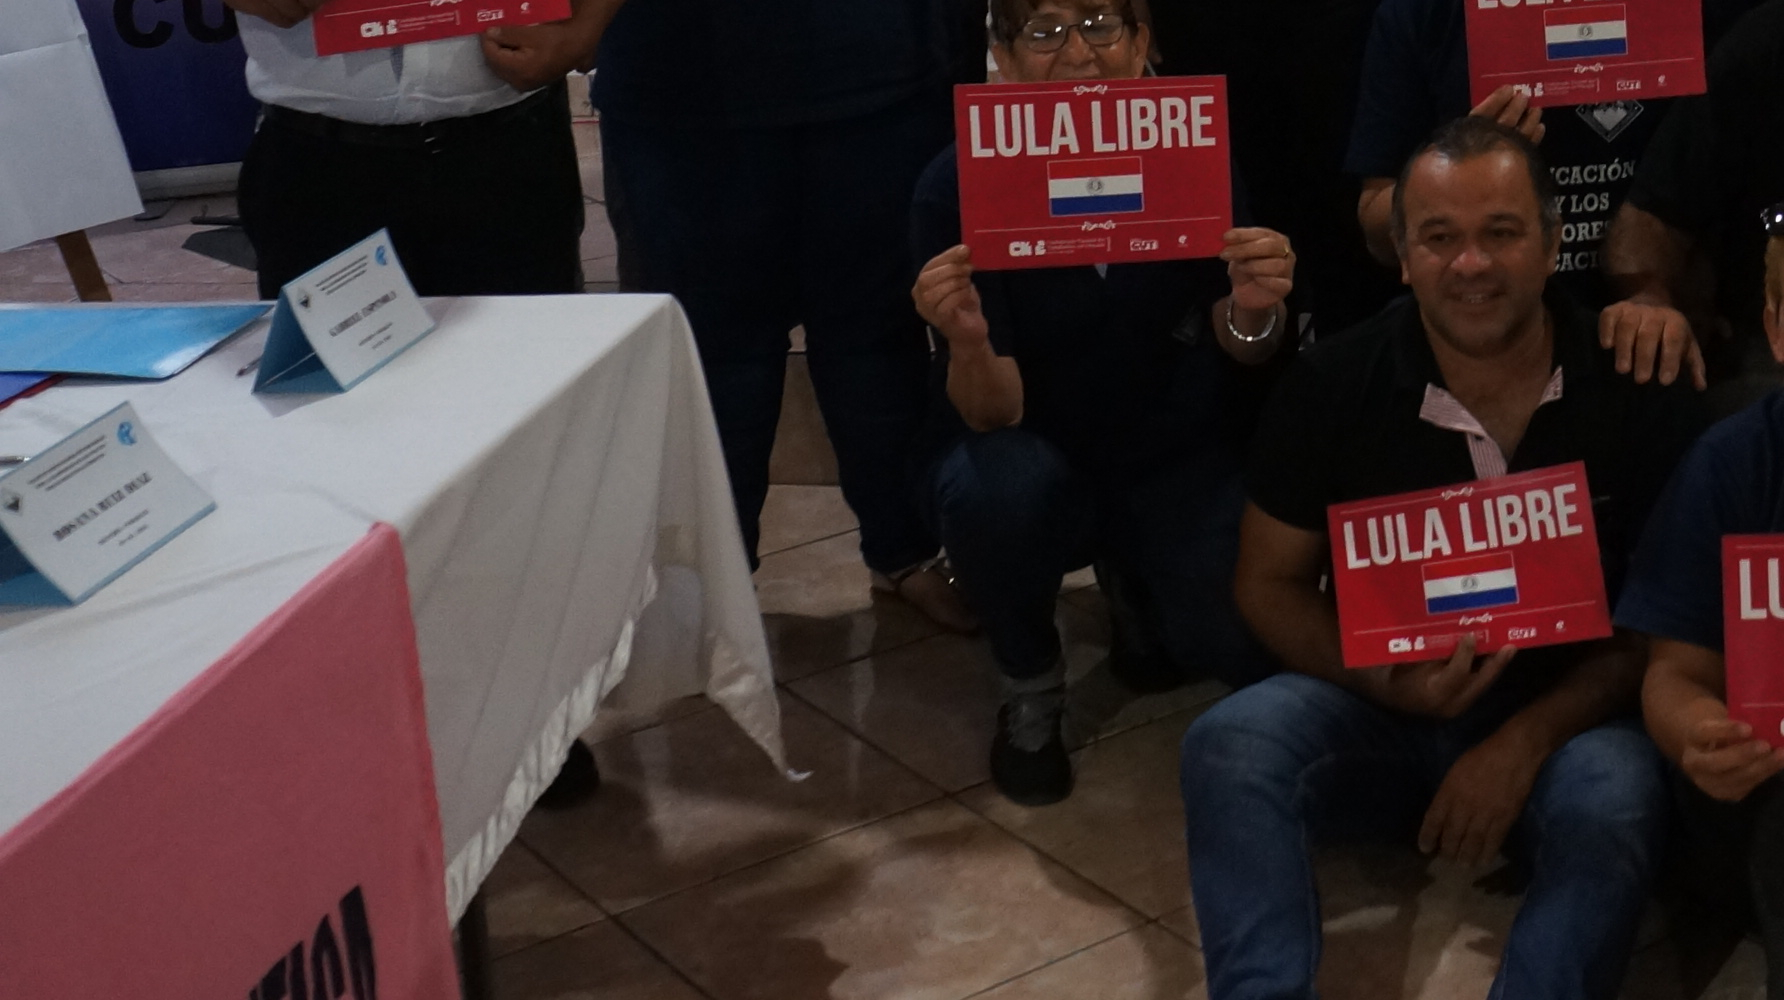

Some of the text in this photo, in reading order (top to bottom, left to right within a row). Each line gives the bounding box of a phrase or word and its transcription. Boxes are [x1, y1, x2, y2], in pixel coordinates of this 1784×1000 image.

[968, 95, 1216, 158] LULA LIBRE
[1570, 192, 1610, 213] LOS
[1343, 483, 1583, 570] LULA LIBRE
